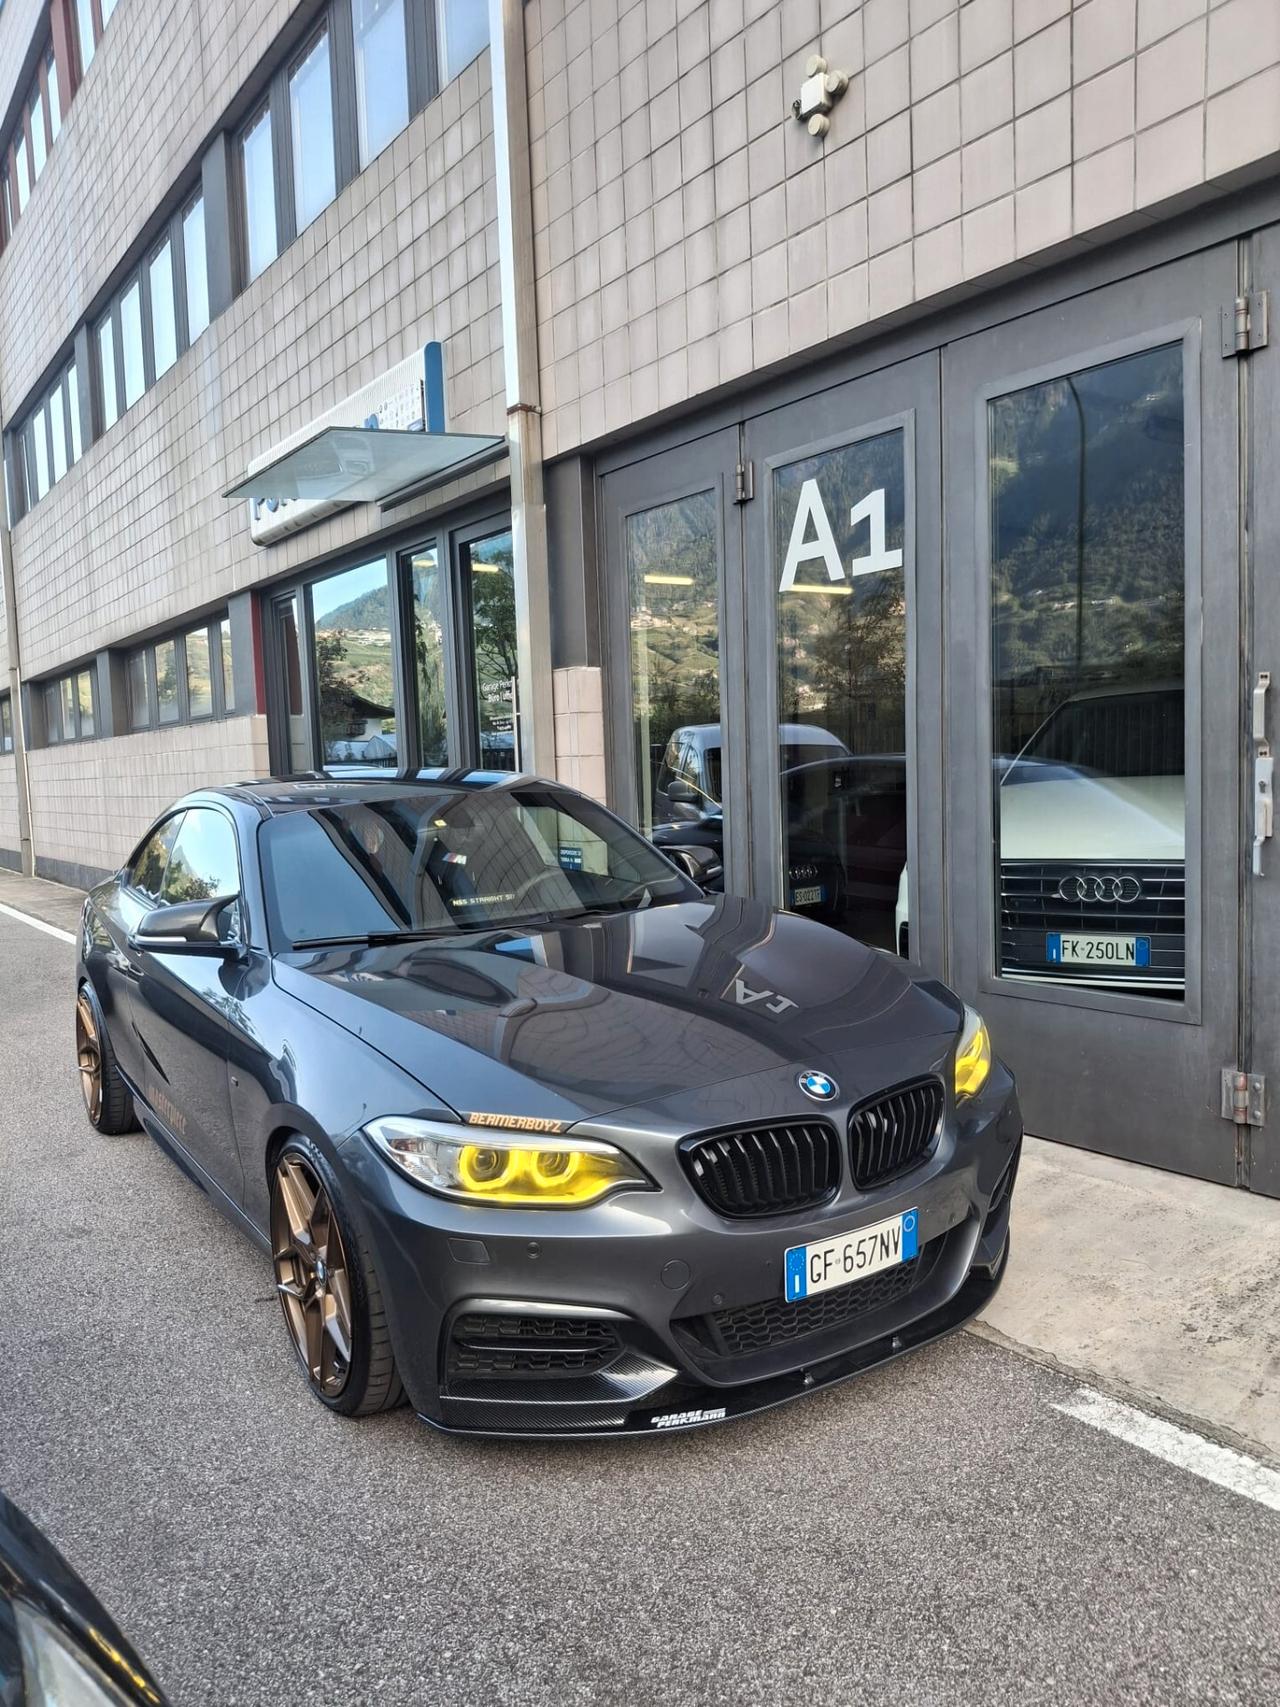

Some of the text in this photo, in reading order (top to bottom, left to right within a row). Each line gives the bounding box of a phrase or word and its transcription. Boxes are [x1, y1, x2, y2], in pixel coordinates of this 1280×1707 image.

[778, 478, 903, 593] A1
[1061, 940, 1080, 958] FK
[1085, 941, 1135, 961] 250LN
[468, 1111, 563, 1133] BEAMERBOYZ
[810, 1248, 835, 1284] GF
[842, 1225, 901, 1274] 657NV
[650, 1409, 703, 1424] GARAGE
